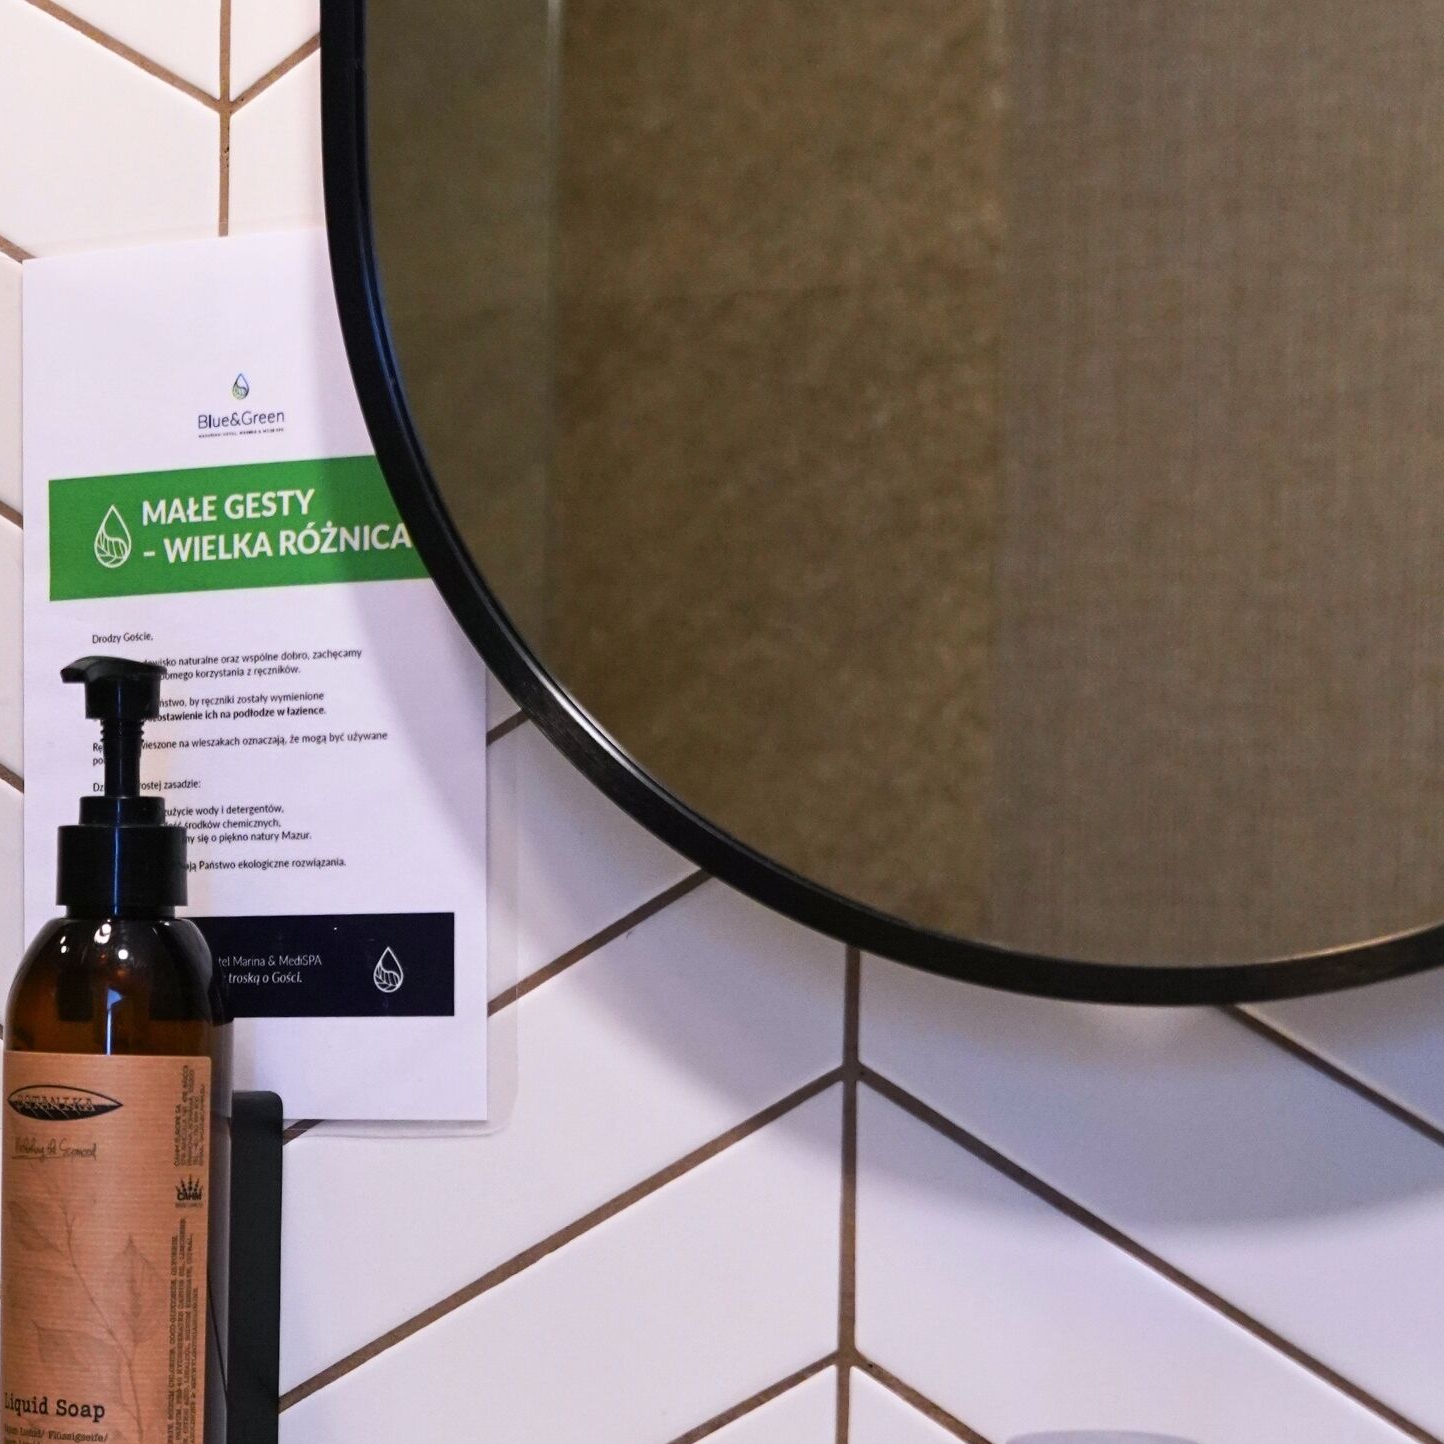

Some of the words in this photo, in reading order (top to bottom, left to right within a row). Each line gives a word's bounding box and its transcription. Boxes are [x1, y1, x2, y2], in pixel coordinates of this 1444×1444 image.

[198, 411, 285, 429] Blue&Green
[142, 497, 216, 526] MAŁE
[224, 488, 316, 521] GESTY
[163, 531, 275, 564] WIELKA
[279, 520, 413, 558] RÓŻNICA
[92, 634, 121, 645] Drodzy
[179, 655, 218, 666] naturalne
[220, 655, 240, 664] oraz
[242, 652, 279, 665] wspólne
[312, 649, 363, 661] zachęcamy
[195, 666, 245, 679] korzystania
[247, 668, 252, 677] z
[189, 697, 200, 708] by
[201, 695, 235, 707] ręczniki
[237, 692, 268, 705] zostały
[270, 691, 325, 703] wymienione
[205, 710, 218, 720] ich
[220, 710, 231, 719] na
[233, 707, 275, 720] podłodze
[277, 708, 285, 717] w
[179, 739, 190, 748] na
[192, 736, 240, 747] wieszakach
[290, 734, 300, 744] że
[302, 734, 328, 745] mogą
[329, 732, 345, 743] być
[347, 731, 388, 743] używane
[164, 779, 202, 790] zasadzie:
[195, 805, 218, 817] wody
[184, 819, 221, 830] środków
[197, 833, 209, 845] się
[211, 835, 217, 843] o
[219, 831, 248, 844] piękno
[250, 832, 279, 843] natury
[199, 859, 236, 870] Państwo
[238, 858, 289, 871] ekologiczne
[233, 955, 266, 967] Marina
[268, 955, 276, 967] &
[279, 954, 323, 967] MediSPA
[228, 972, 260, 986] troską
[262, 974, 269, 984] o
[4, 1392, 49, 1416] Liquid
[56, 1398, 105, 1422] Soap
